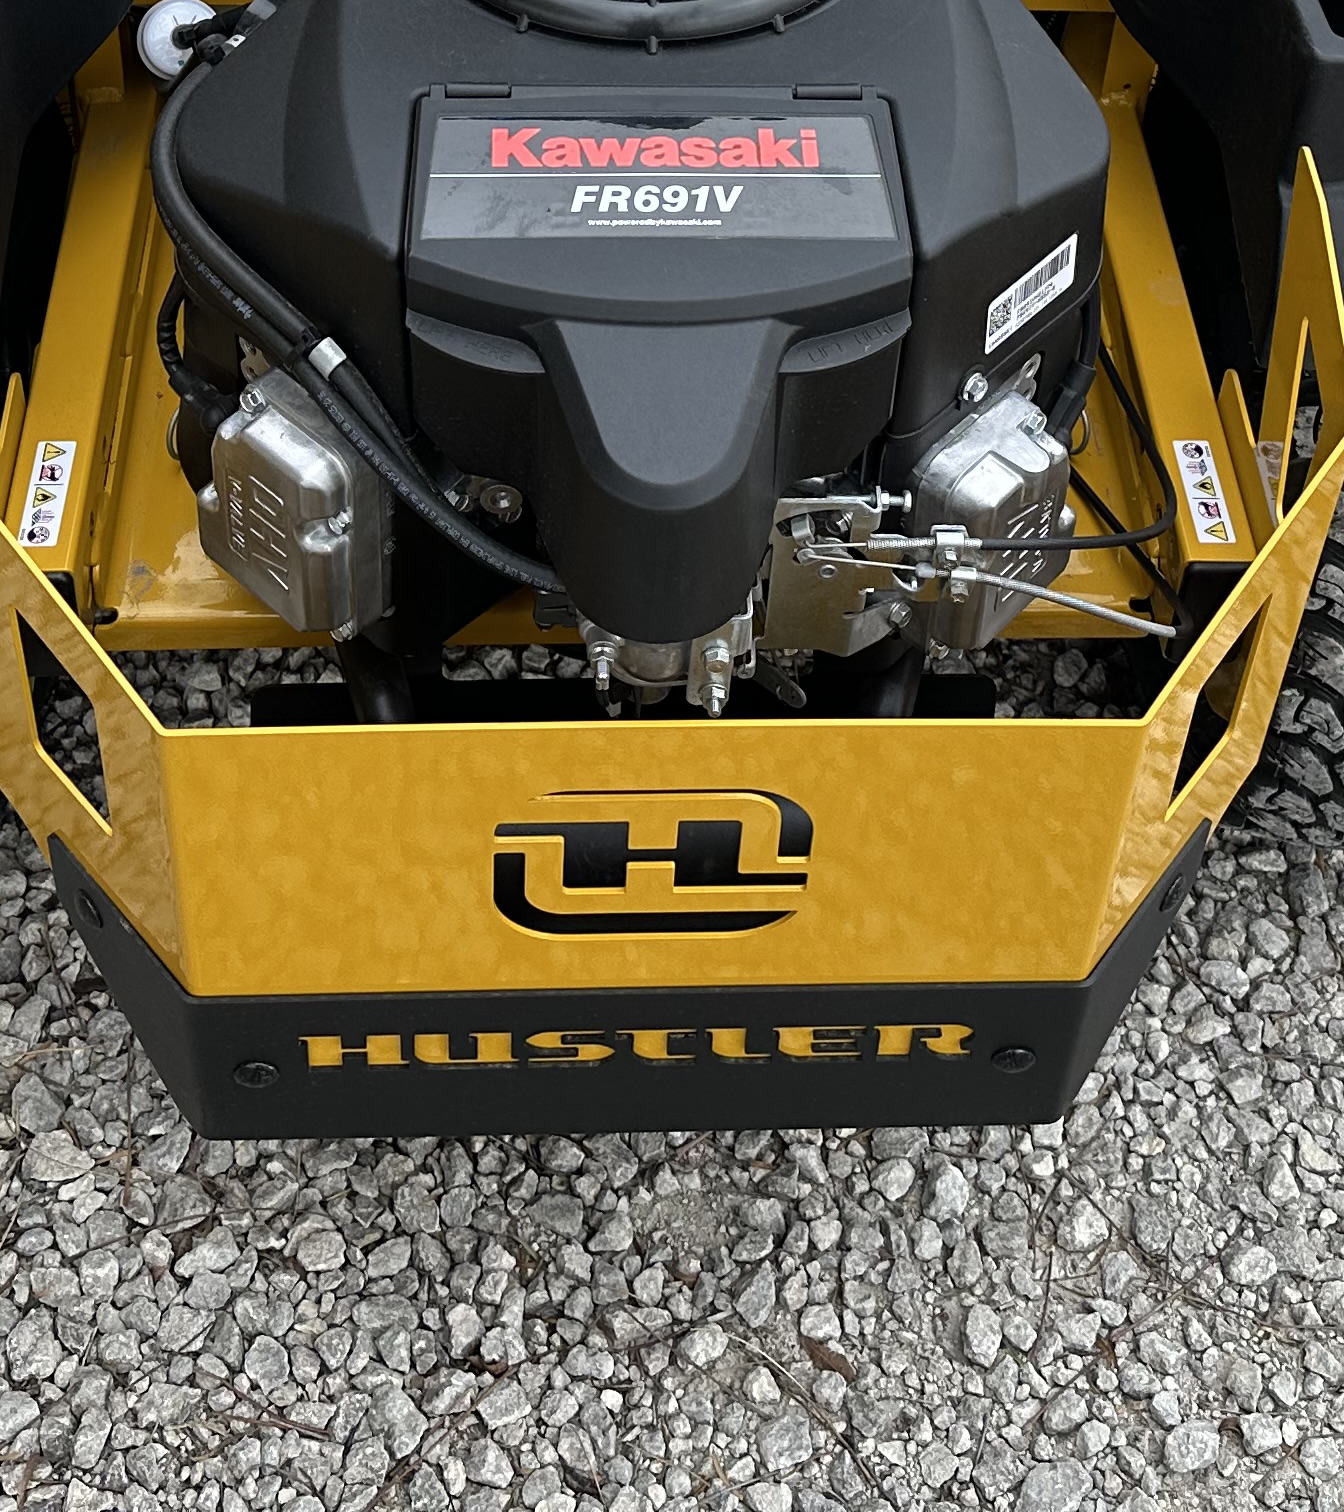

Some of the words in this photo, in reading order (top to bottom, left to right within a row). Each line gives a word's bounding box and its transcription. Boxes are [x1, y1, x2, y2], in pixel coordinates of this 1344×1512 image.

[491, 127, 821, 169] Kawasaki
[569, 185, 745, 214] FR691V
[297, 1024, 975, 1070] HUSTLER
